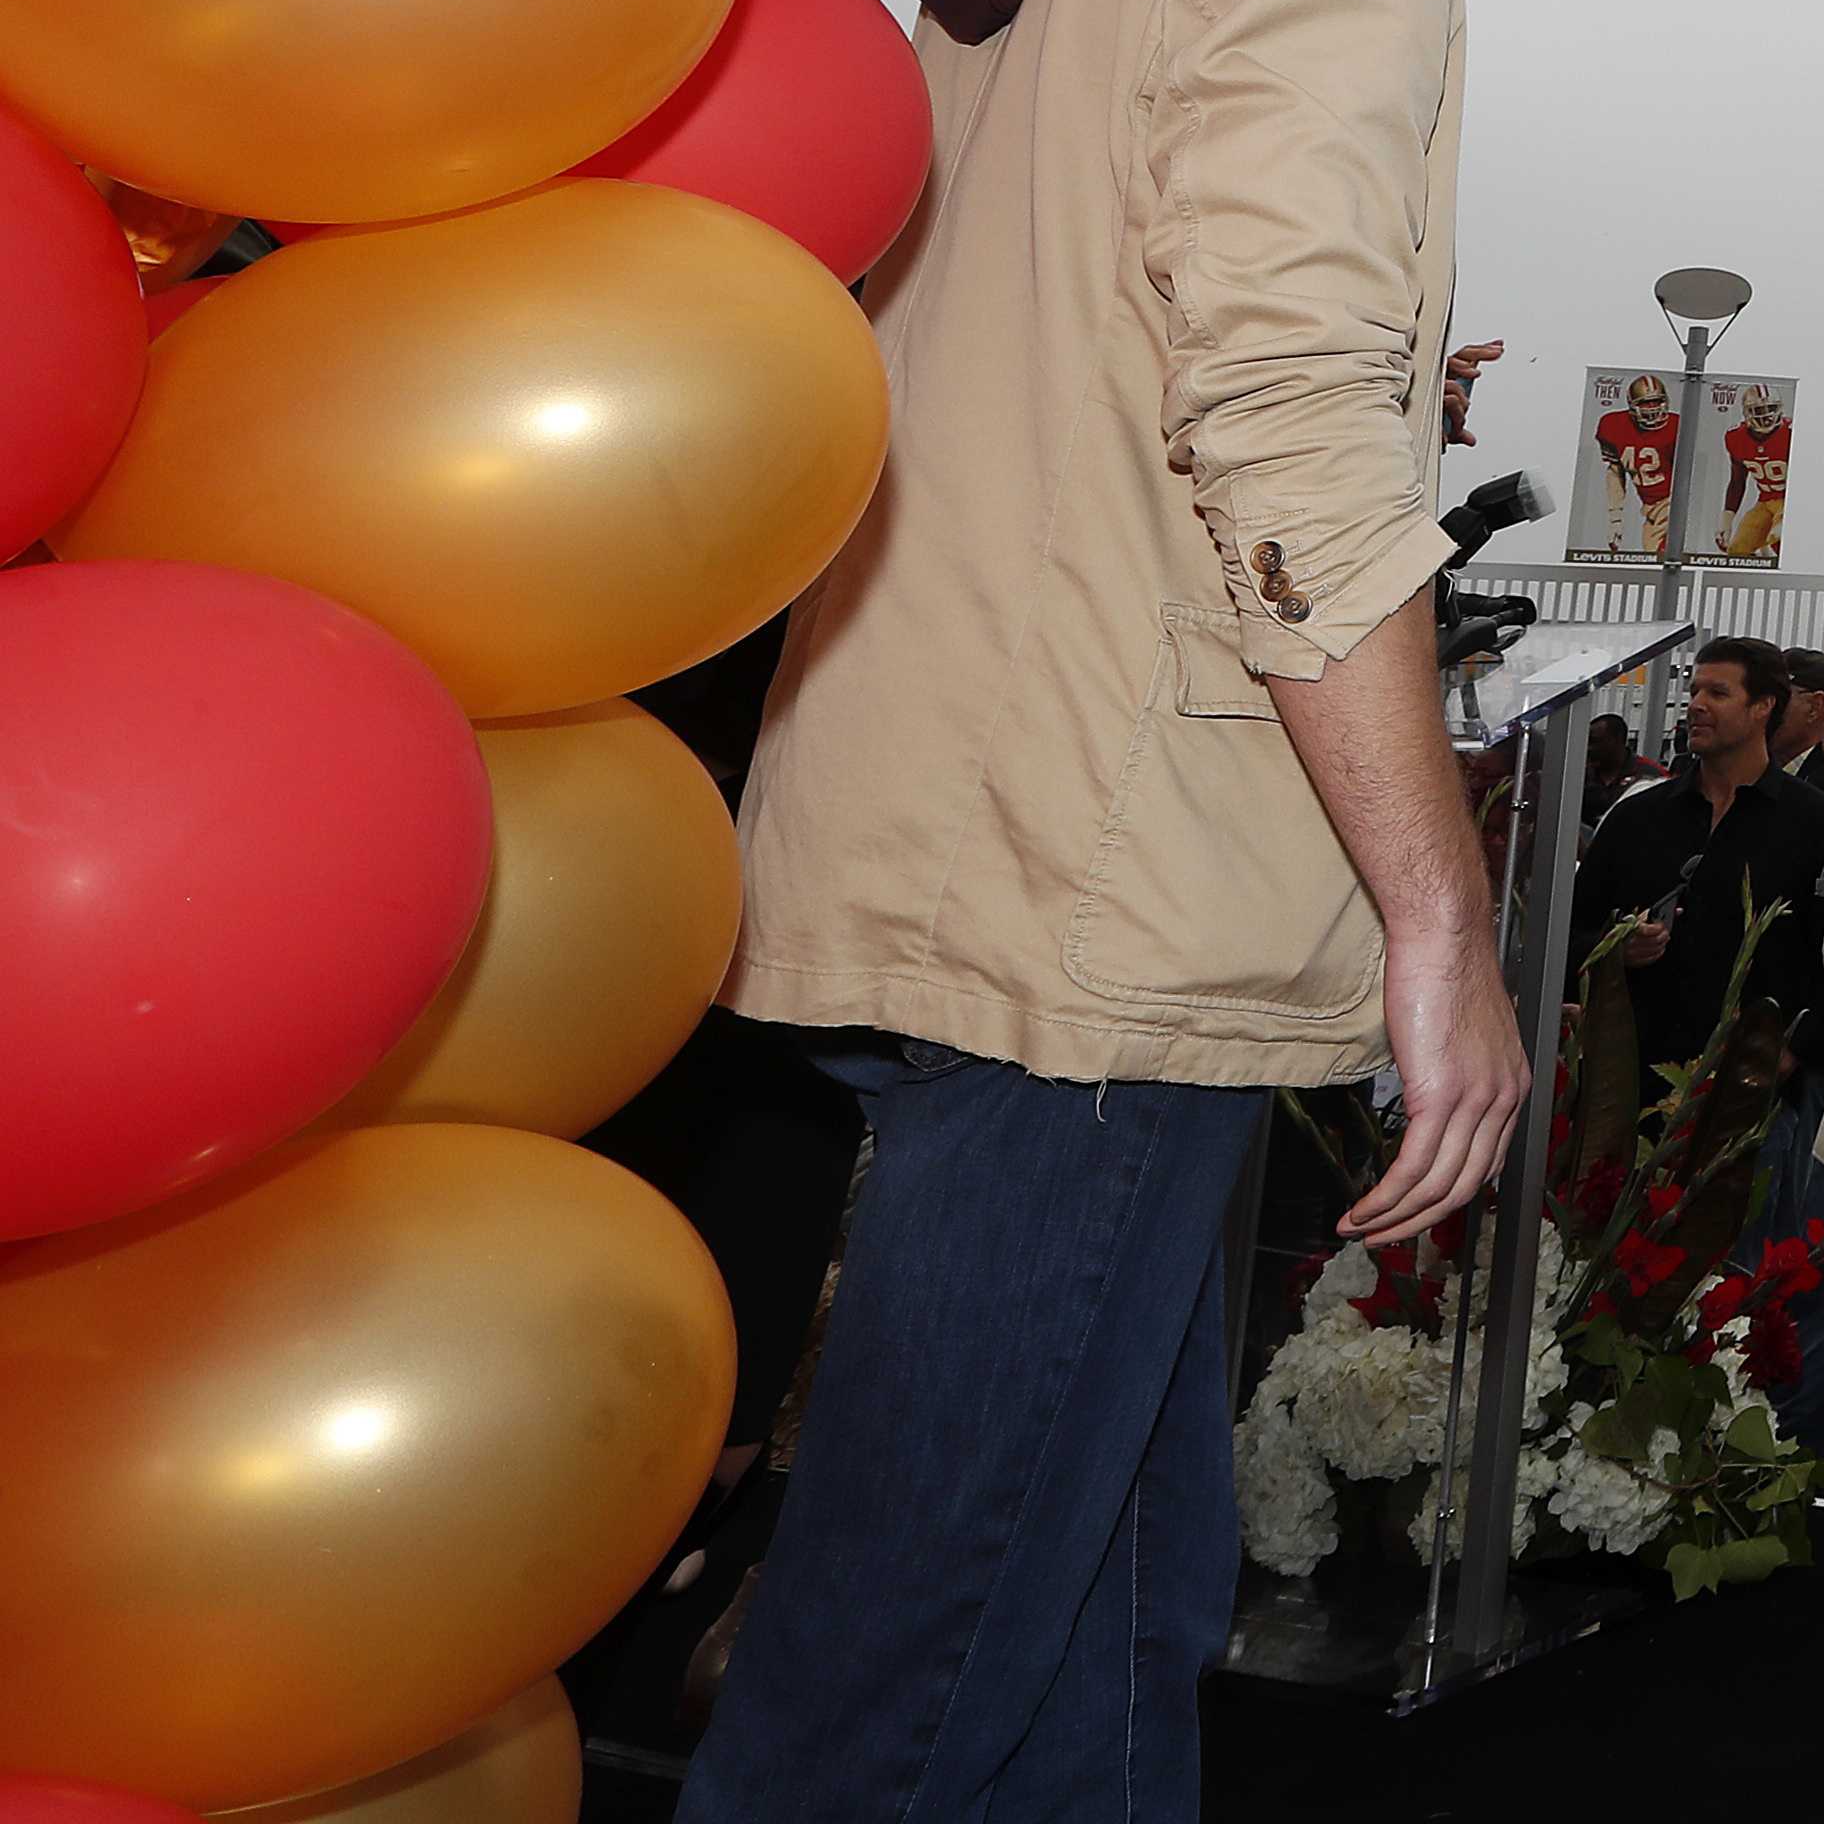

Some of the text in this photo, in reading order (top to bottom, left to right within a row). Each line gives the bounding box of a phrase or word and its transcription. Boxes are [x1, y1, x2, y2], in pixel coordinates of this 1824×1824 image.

[1595, 384, 1620, 399] THEN
[1712, 391, 1736, 405] NOW
[1613, 554, 1657, 563] STADIUM
[1729, 558, 1771, 568] STADIUM
